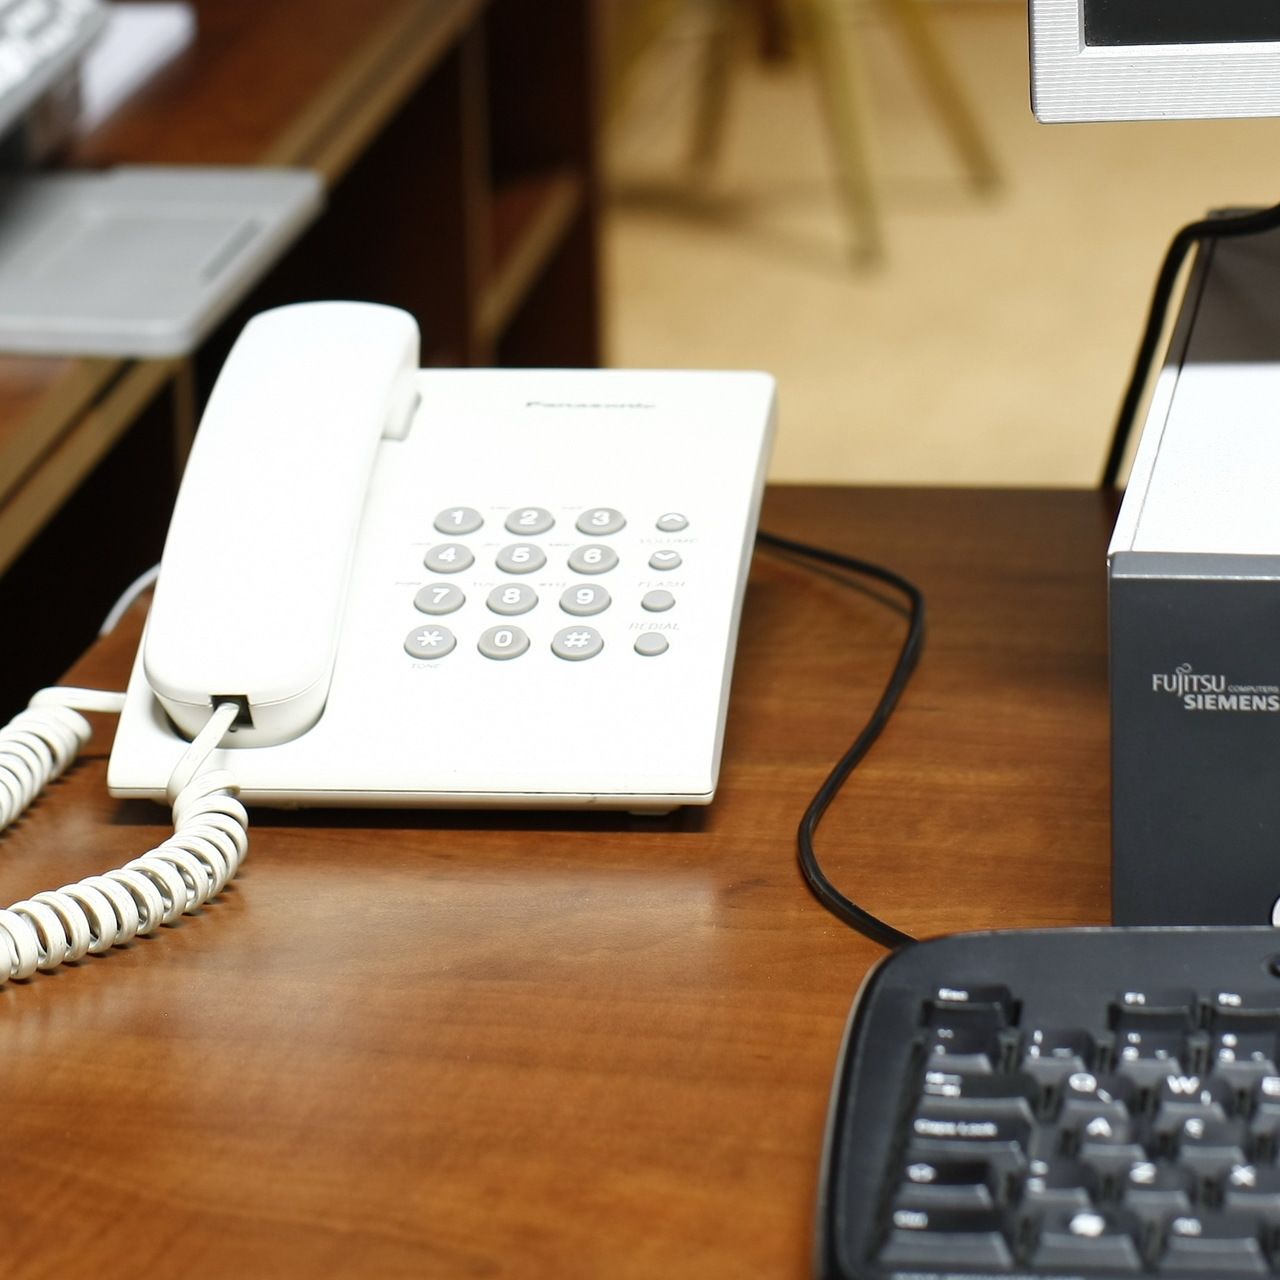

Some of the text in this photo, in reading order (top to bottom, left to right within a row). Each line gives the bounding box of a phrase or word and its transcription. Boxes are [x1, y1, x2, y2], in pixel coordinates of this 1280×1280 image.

[451, 509, 610, 526] 1 2 3
[438, 547, 602, 563] 4 5 6
[432, 588, 595, 604] 7 8 9
[628, 622, 680, 631] REDIAL
[493, 630, 513, 647] 0
[1152, 663, 1226, 697] FUJITSU
[1184, 694, 1280, 711] SIEMENS
